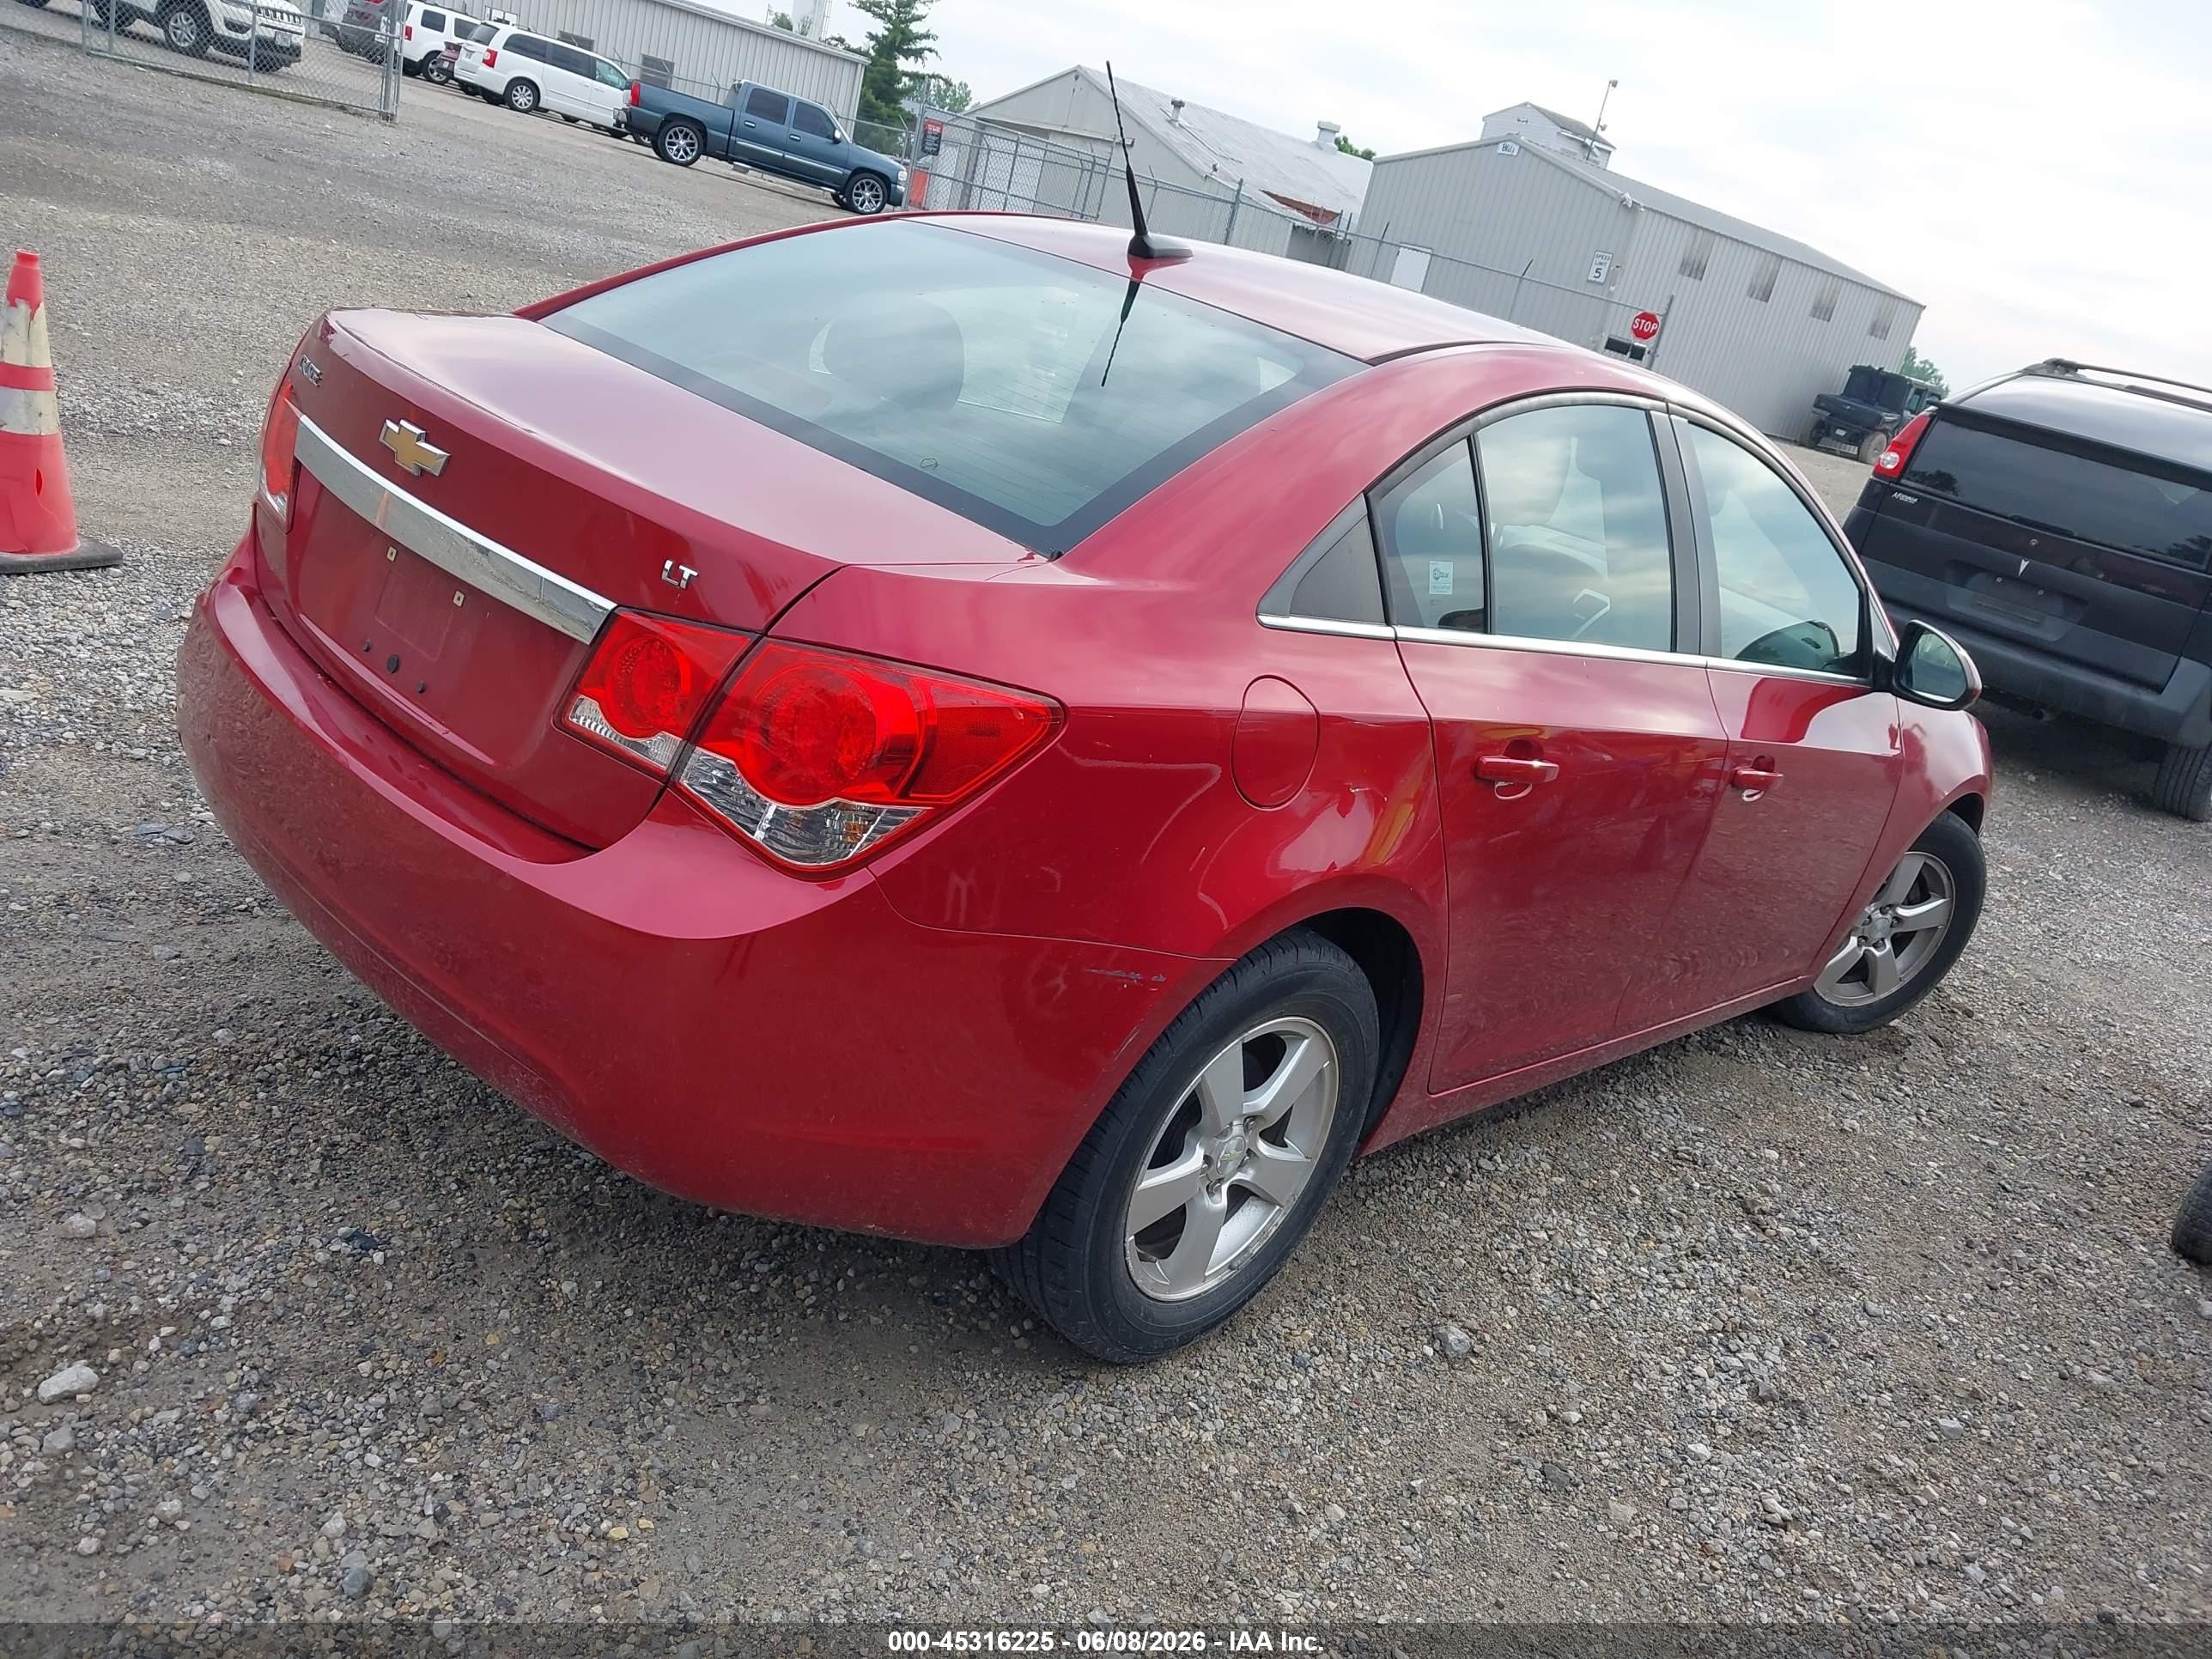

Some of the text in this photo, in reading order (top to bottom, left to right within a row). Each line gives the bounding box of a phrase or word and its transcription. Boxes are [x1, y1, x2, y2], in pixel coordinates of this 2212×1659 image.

[1594, 267, 1602, 279] 5
[1632, 318, 1658, 333] STOP
[661, 559, 698, 590] LT
